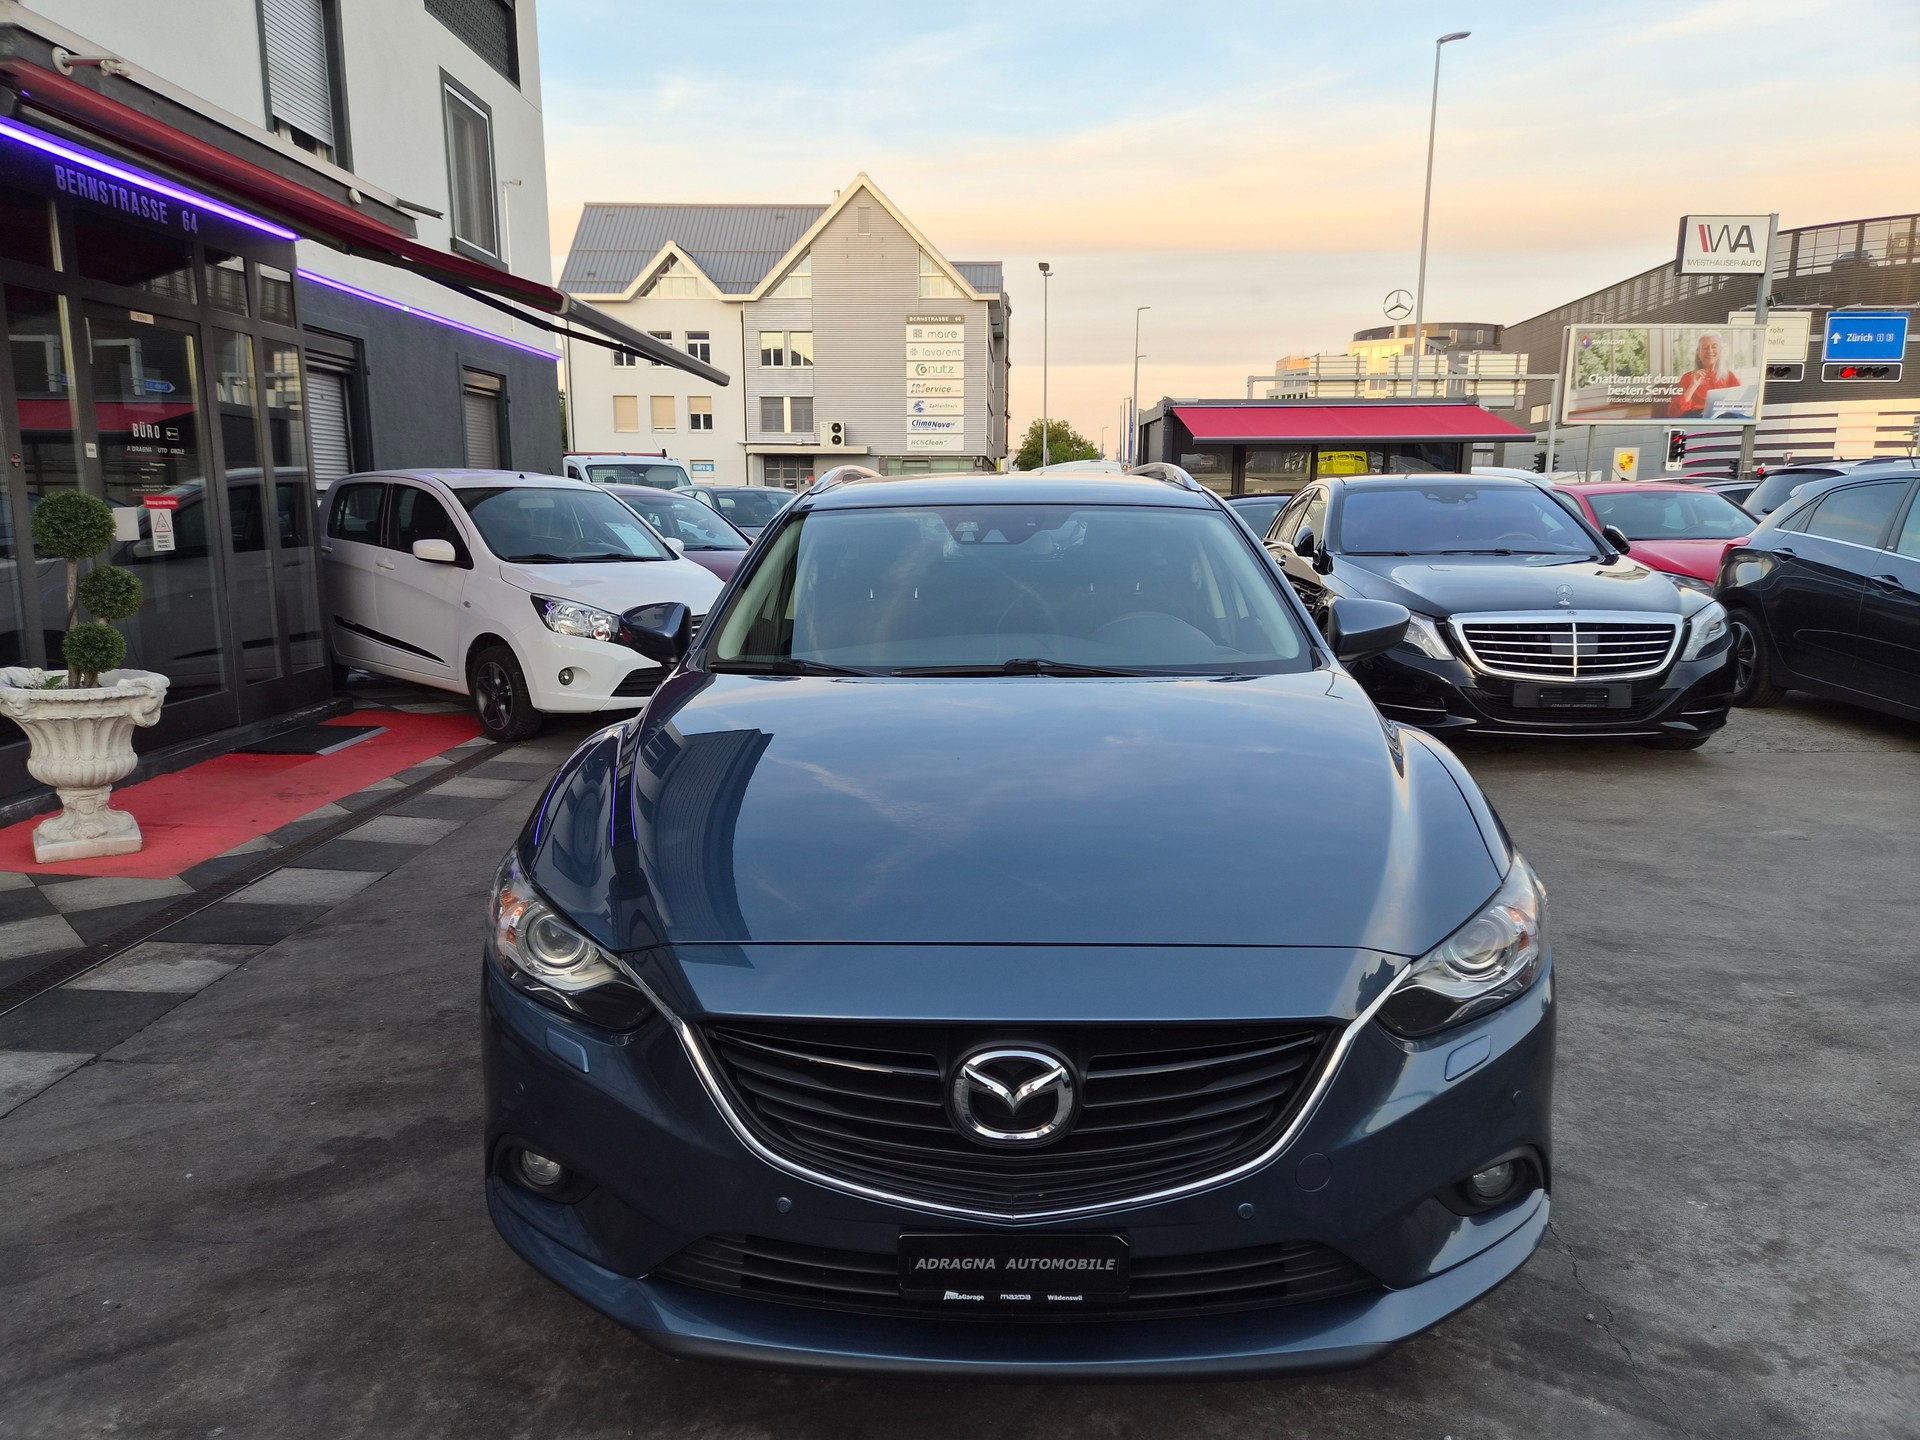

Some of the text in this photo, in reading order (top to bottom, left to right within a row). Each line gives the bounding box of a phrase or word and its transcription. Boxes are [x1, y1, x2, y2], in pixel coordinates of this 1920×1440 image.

[54, 164, 198, 234] BERNSTRASSE 64
[927, 328, 957, 339] maire
[1846, 333, 1873, 342] Zürich
[1592, 337, 1626, 346] swisscom
[922, 347, 961, 357] lavorent
[928, 364, 955, 374] nutz
[1588, 373, 1680, 384] Chatten mit dem
[1607, 384, 1684, 396] besten Service
[911, 419, 951, 428] ClimaNova
[132, 421, 161, 439] BÜRO
[915, 1258, 1116, 1271] ADRAGNA AUTOMOBILE
